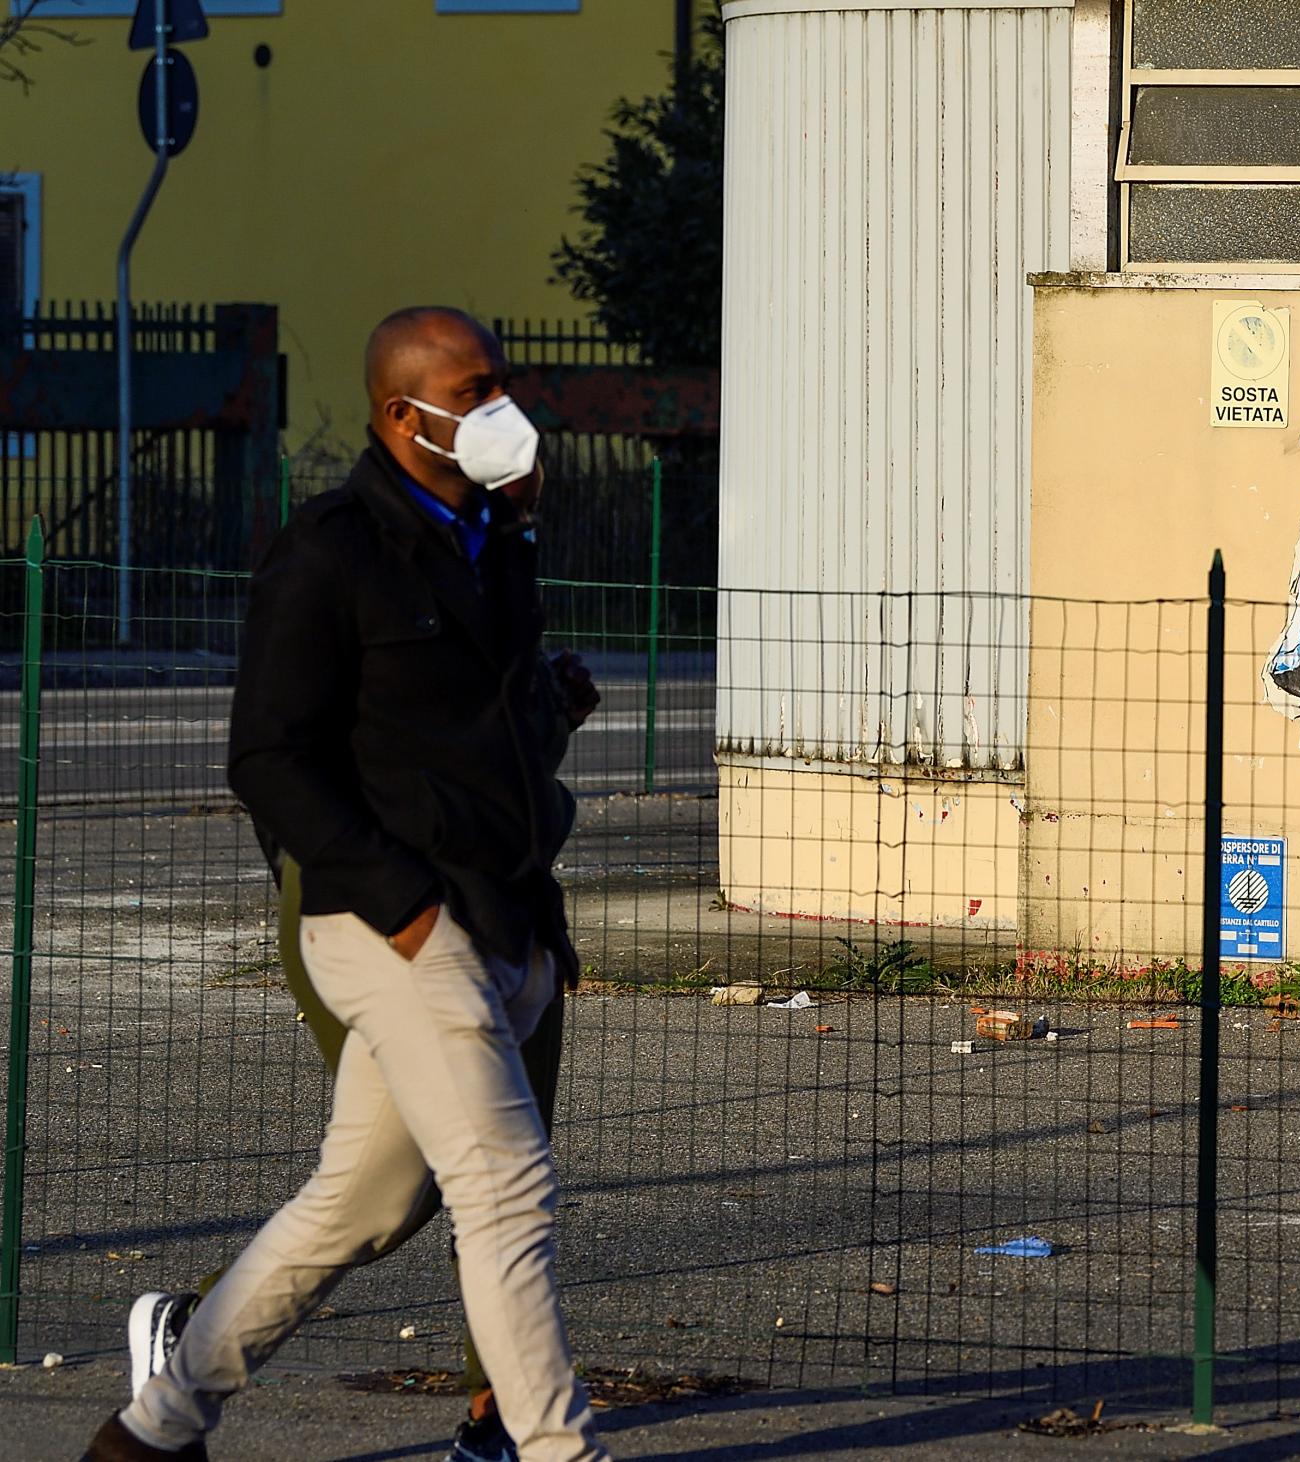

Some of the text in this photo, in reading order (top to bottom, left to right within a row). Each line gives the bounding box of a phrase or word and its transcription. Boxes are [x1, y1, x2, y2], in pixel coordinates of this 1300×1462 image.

[1222, 387, 1278, 402] SOSTA
[1216, 406, 1284, 422] VIETATA
[1271, 843, 1281, 854] DI
[1222, 853, 1245, 864] ERRA
[1253, 919, 1279, 927] CARTELLO
